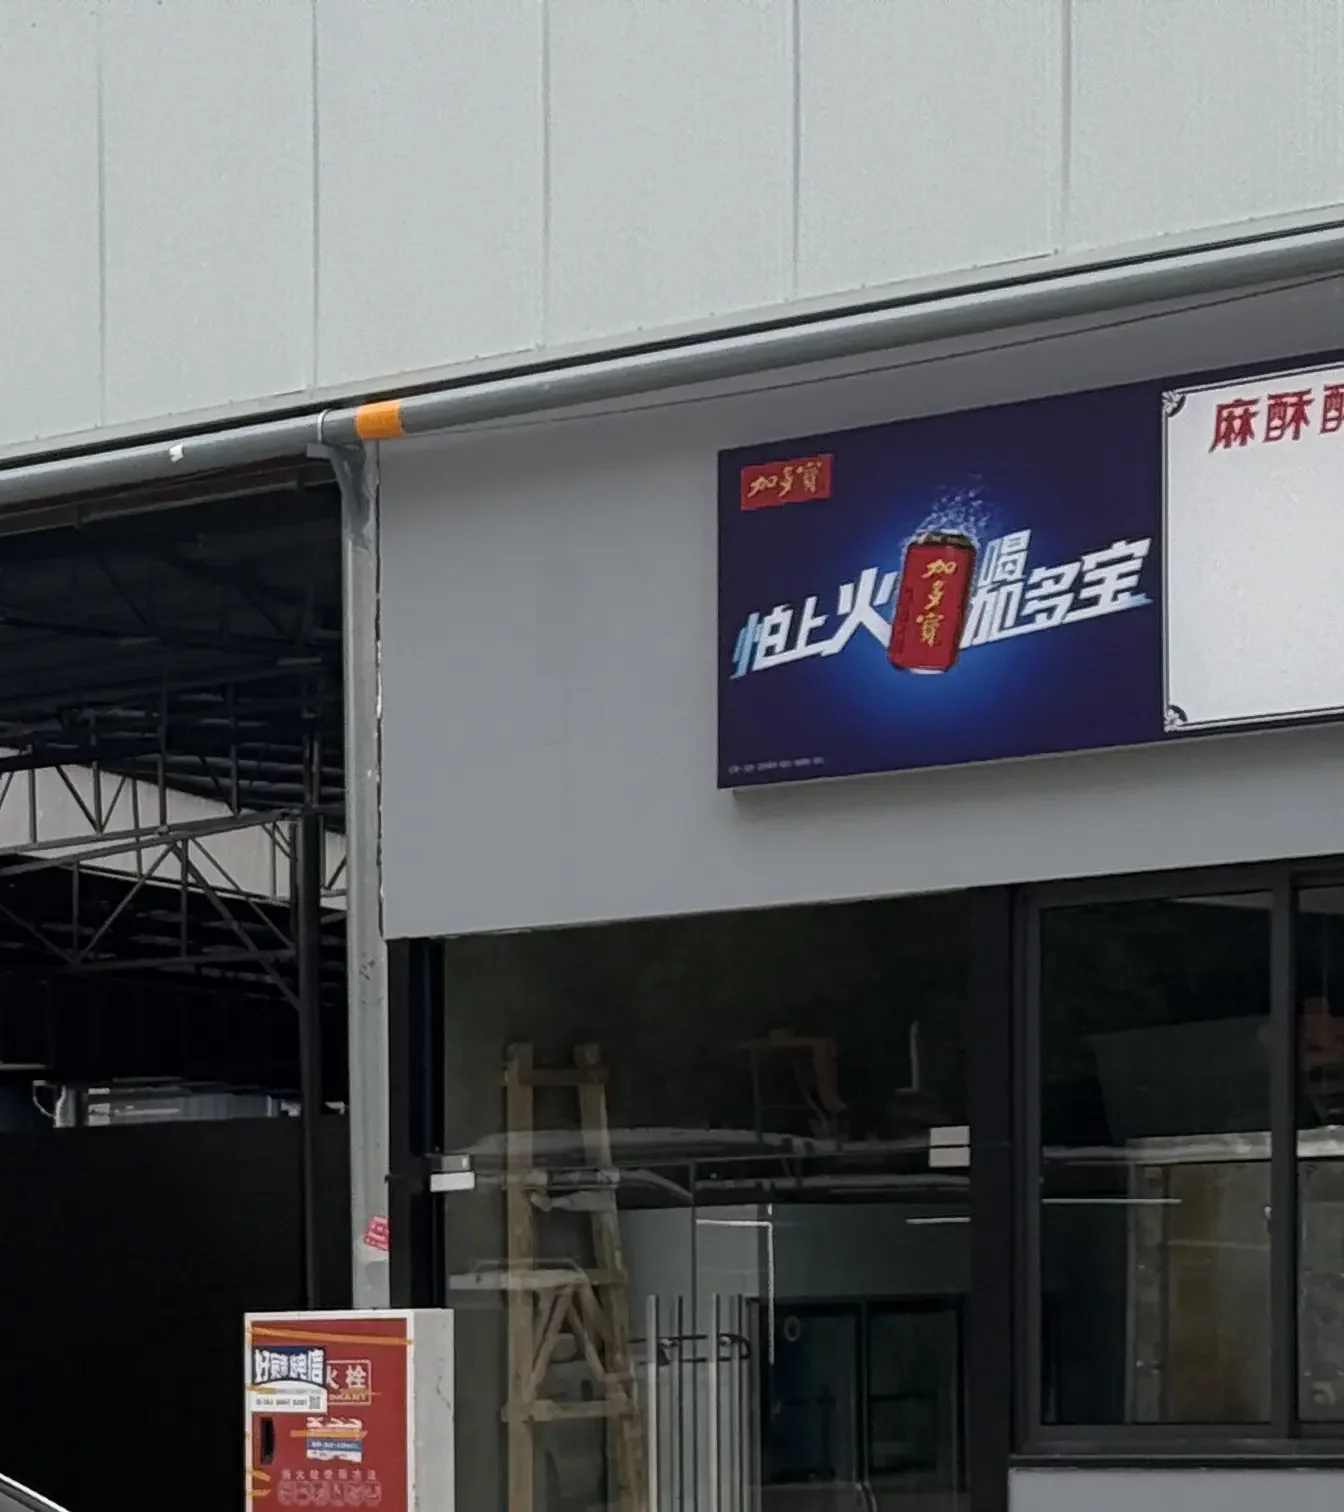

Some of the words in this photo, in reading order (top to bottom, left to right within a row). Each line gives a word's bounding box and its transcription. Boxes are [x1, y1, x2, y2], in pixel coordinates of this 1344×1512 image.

[730, 567, 900, 679] 怕上火
[959, 529, 1154, 650] 喝加多宝
